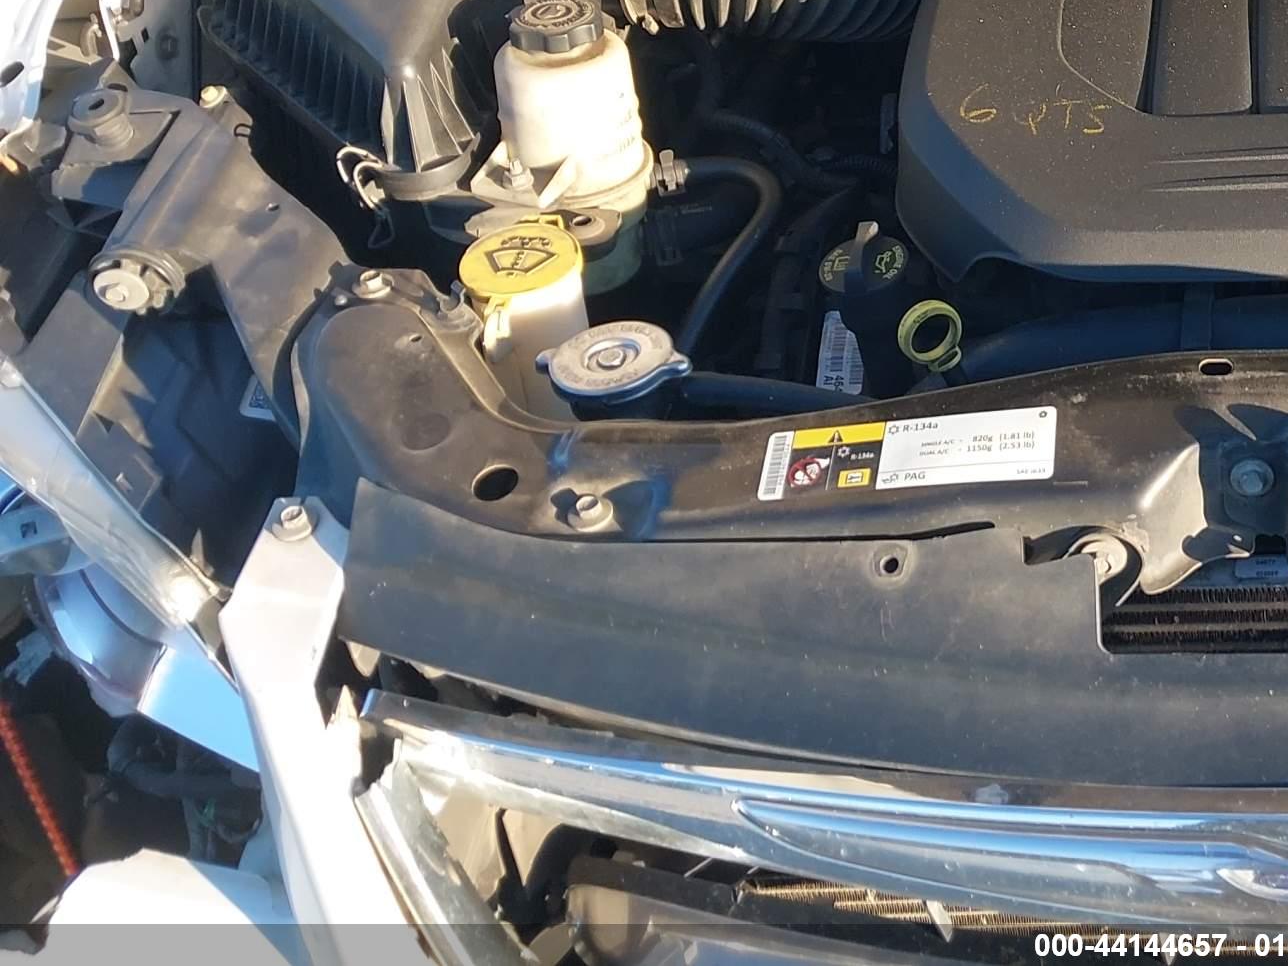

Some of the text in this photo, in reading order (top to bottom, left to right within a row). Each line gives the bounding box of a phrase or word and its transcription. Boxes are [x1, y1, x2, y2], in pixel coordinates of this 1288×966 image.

[882, 245, 904, 280] ENGINE OIL
[902, 421, 939, 432] R-134a
[972, 434, 993, 443] 820g
[967, 444, 992, 453] 1150g
[904, 471, 926, 481] PAG
